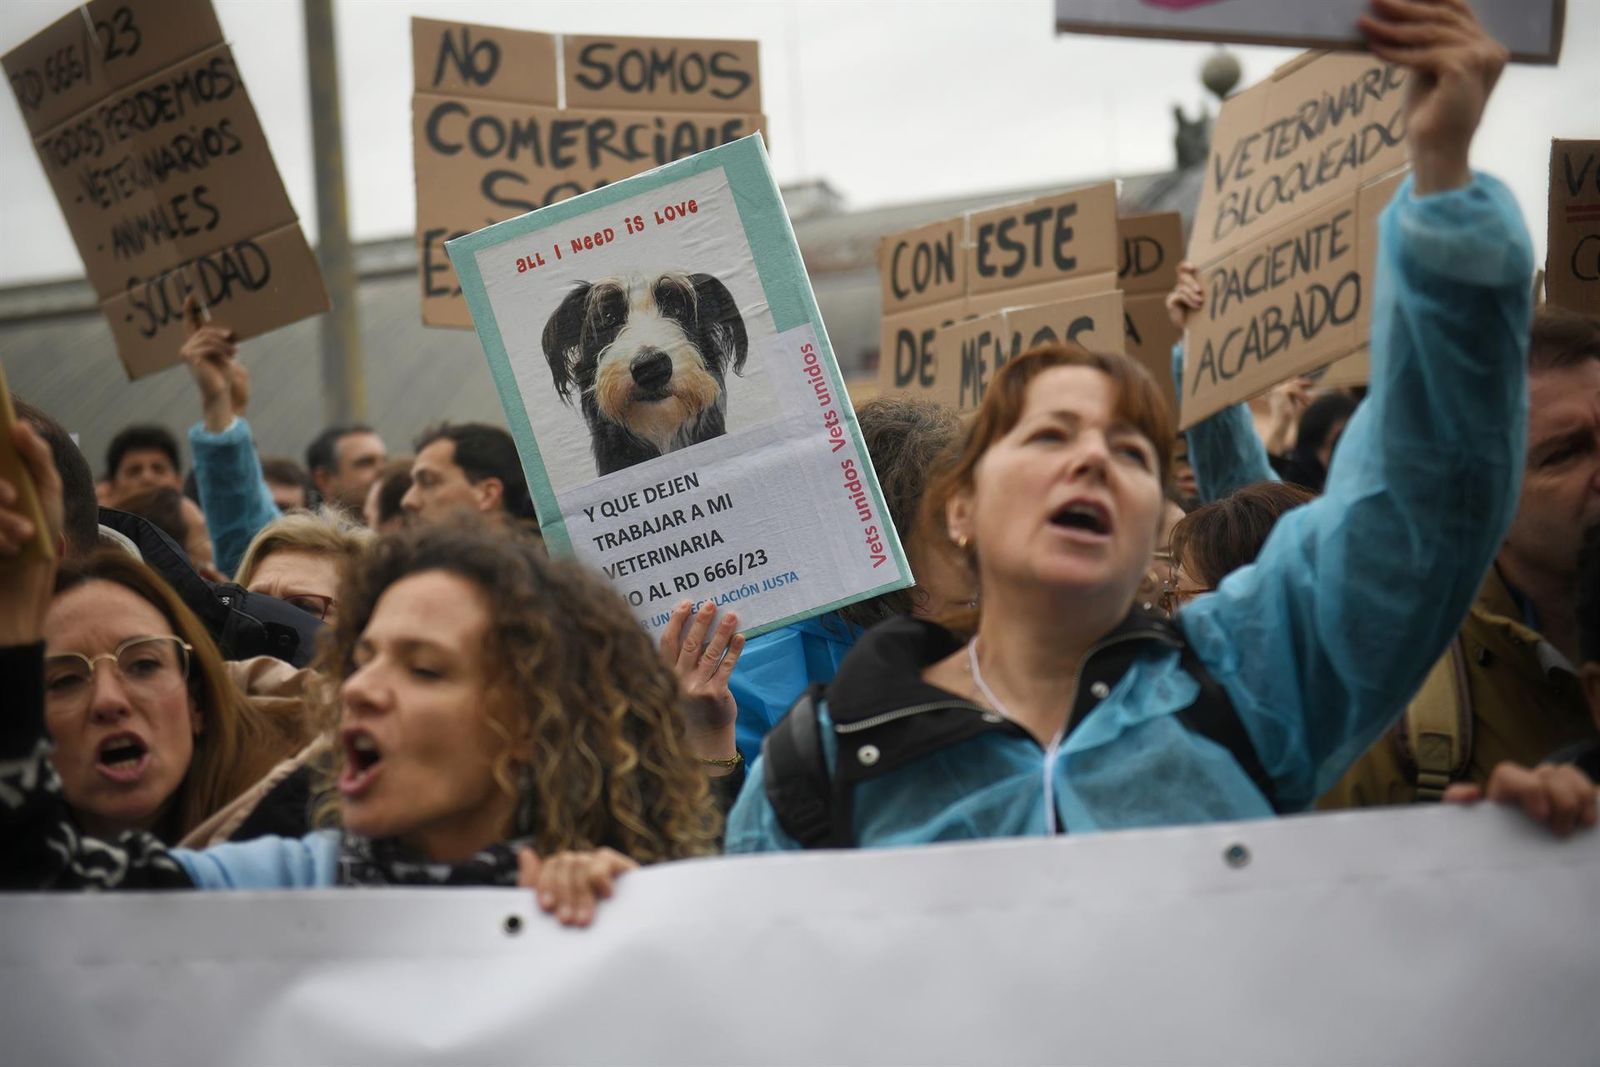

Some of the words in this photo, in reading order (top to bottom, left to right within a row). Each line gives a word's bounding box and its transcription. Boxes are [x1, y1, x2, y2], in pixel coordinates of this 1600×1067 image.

[433, 27, 502, 87] NO
[574, 43, 753, 100] SOMOS
[553, 244, 562, 260] I
[891, 231, 955, 300] CON
[976, 202, 1078, 278] ESTE
[1209, 210, 1354, 320] PACIENTE
[1191, 270, 1362, 396] ACABADO
[800, 342, 832, 407] unidos
[823, 409, 847, 454] Vets
[583, 506, 595, 523] Y
[600, 492, 640, 518] QUE
[643, 472, 700, 504] DEJEN
[841, 458, 872, 522] unidos
[592, 509, 687, 552] TRABAJAR
[691, 504, 705, 521] A
[706, 493, 733, 515] MI
[865, 525, 887, 569] Vets
[602, 529, 725, 580] VETERINARIA
[649, 582, 672, 602] AL
[673, 571, 700, 593] RD
[703, 549, 769, 582] 666/23
[763, 570, 800, 592] JUSTA
